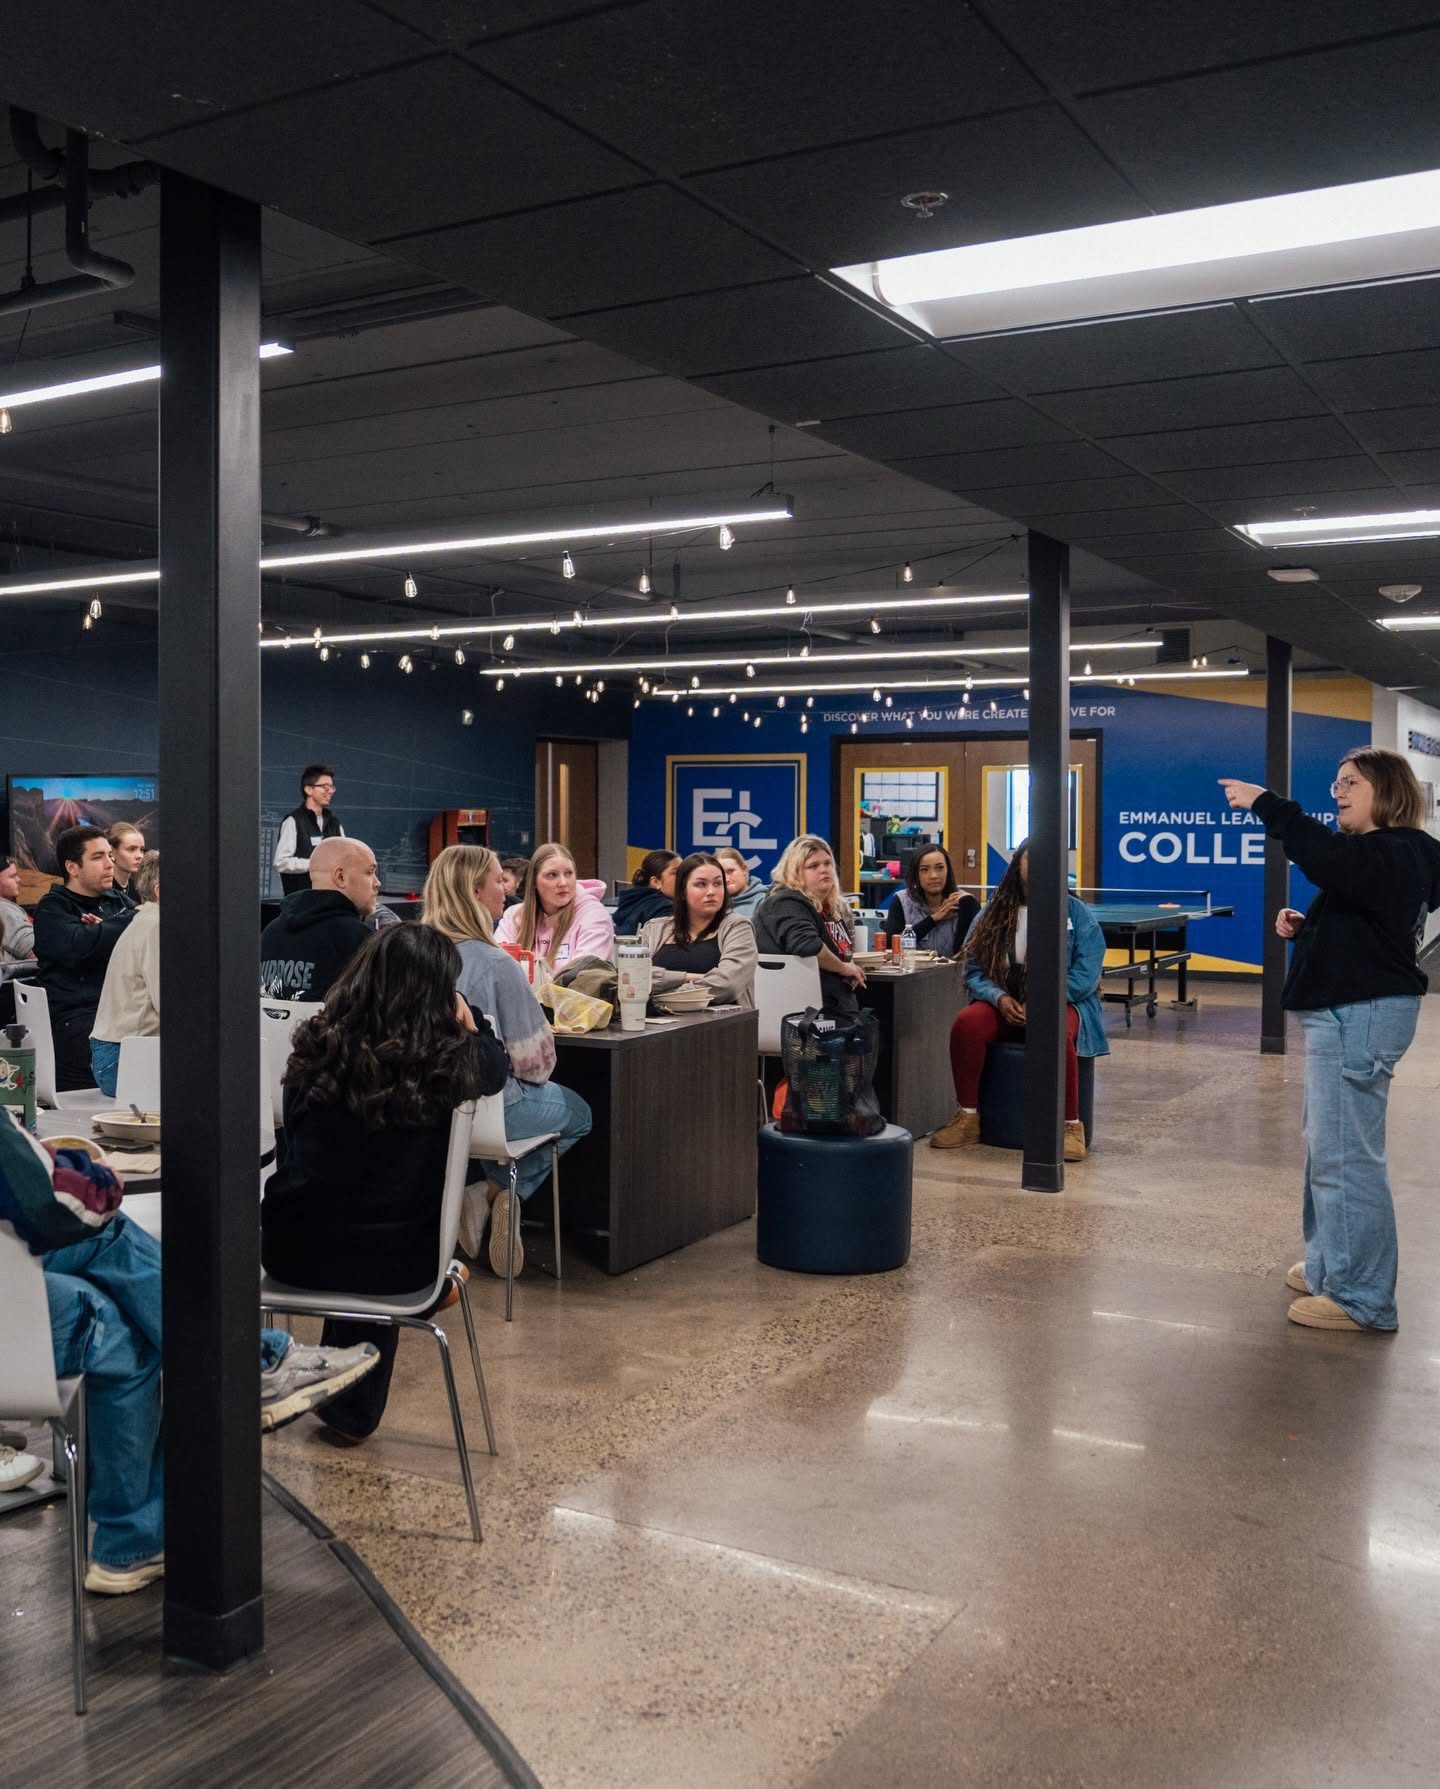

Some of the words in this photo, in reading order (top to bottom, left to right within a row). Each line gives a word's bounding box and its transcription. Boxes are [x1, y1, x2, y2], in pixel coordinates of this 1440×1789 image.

[823, 712, 879, 722] DISCOVER
[881, 711, 915, 721] WHAT
[919, 710, 943, 720] YOU
[945, 709, 980, 720] WERE
[982, 708, 1029, 719] CREATE
[1089, 706, 1116, 716] FOR
[134, 788, 155, 800] 12:51
[1119, 811, 1216, 825] EMMANUEL
[260, 959, 315, 989] URPOSE
